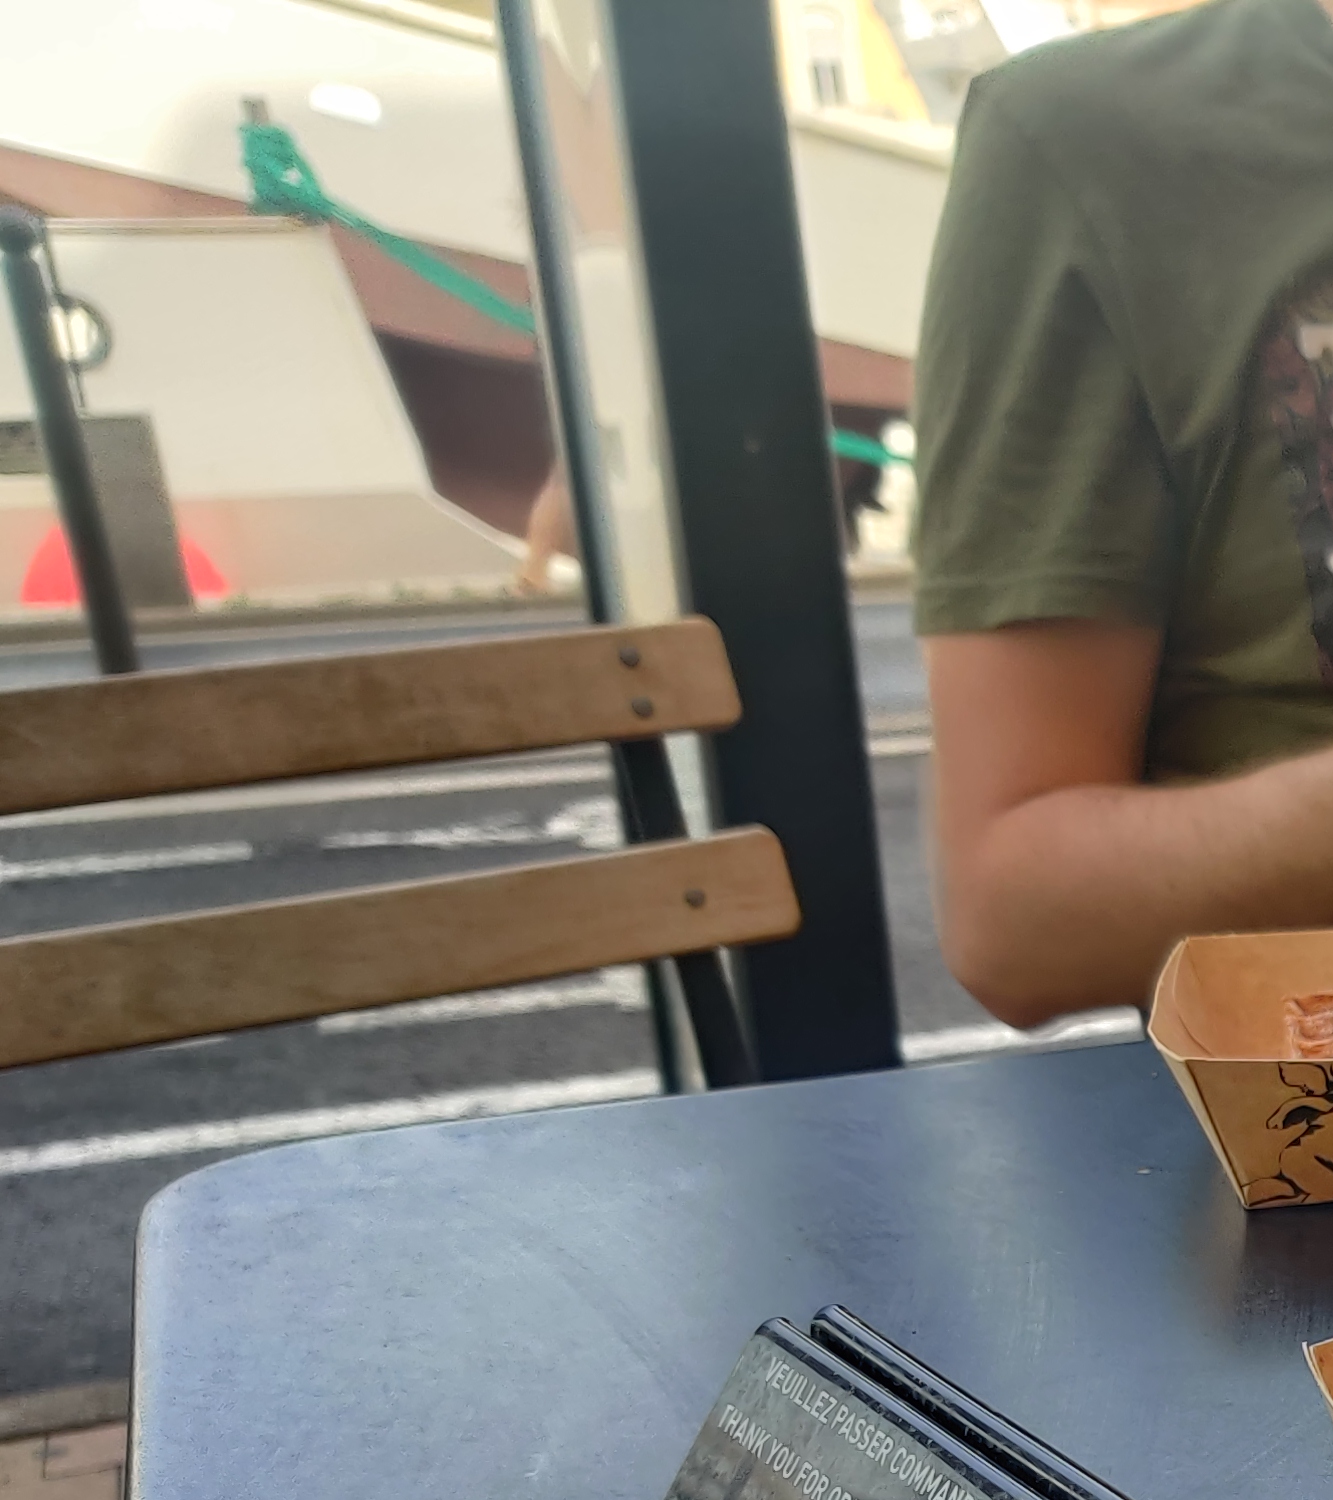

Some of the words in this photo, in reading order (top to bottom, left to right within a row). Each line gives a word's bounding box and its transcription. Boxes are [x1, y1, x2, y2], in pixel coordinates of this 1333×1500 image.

[717, 1404, 772, 1460] THANK
[764, 1438, 801, 1479] YOU
[765, 1356, 838, 1425] VEUILLEZ
[830, 1404, 895, 1467] PASSER
